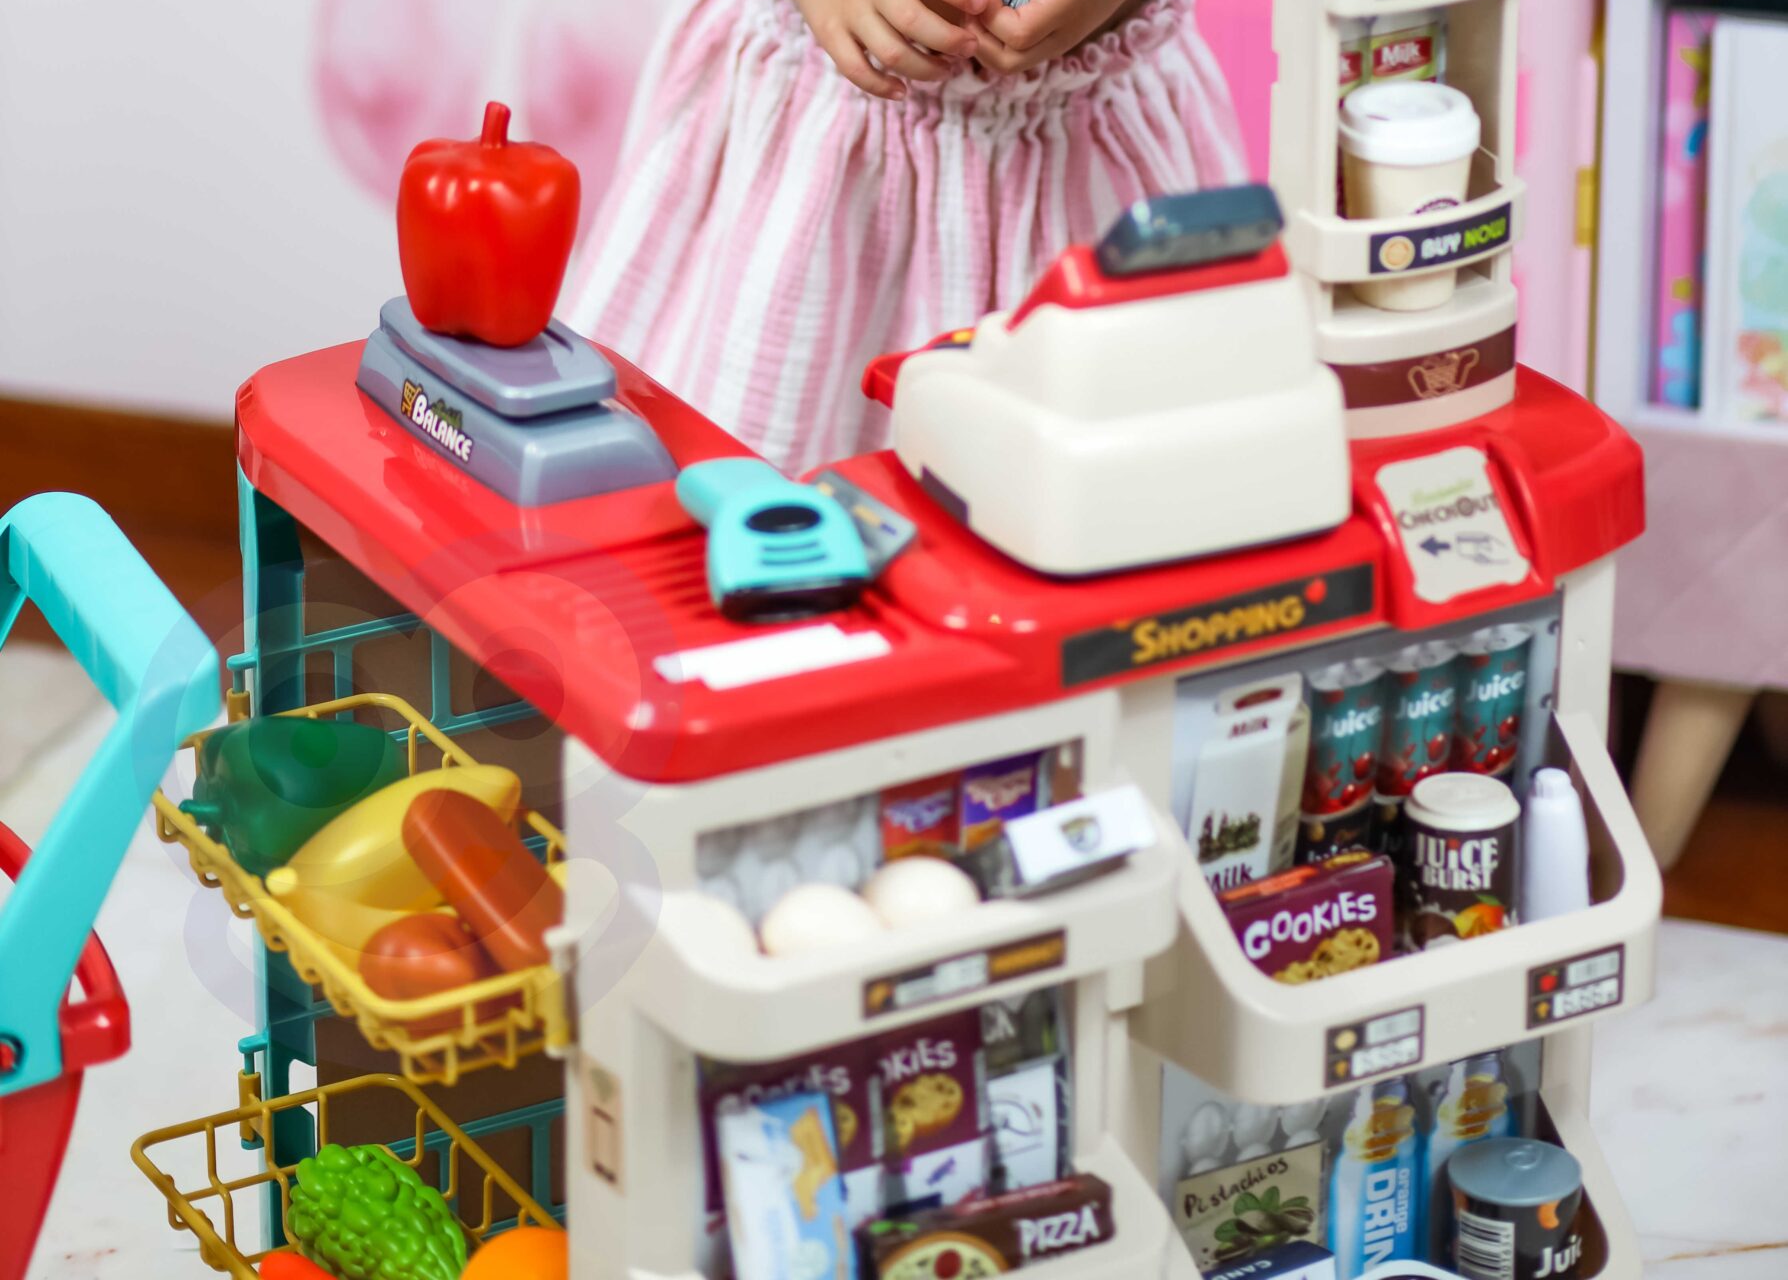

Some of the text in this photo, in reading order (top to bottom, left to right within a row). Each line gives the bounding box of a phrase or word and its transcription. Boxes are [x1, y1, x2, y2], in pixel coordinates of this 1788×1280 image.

[1381, 41, 1421, 66] Milk
[1421, 217, 1507, 259] BUY NOW
[411, 393, 474, 462] BALANCE
[1131, 595, 1305, 664] SHOPPING
[1398, 686, 1455, 720] Juice
[1467, 670, 1526, 702] Juice
[1321, 704, 1383, 740] Juice
[1423, 865, 1495, 891] BURST
[1243, 891, 1378, 960] COOKIES
[1184, 1157, 1289, 1218] Pistachios
[1016, 1206, 1099, 1256] PIZZA
[1363, 1168, 1397, 1273] DRIN
